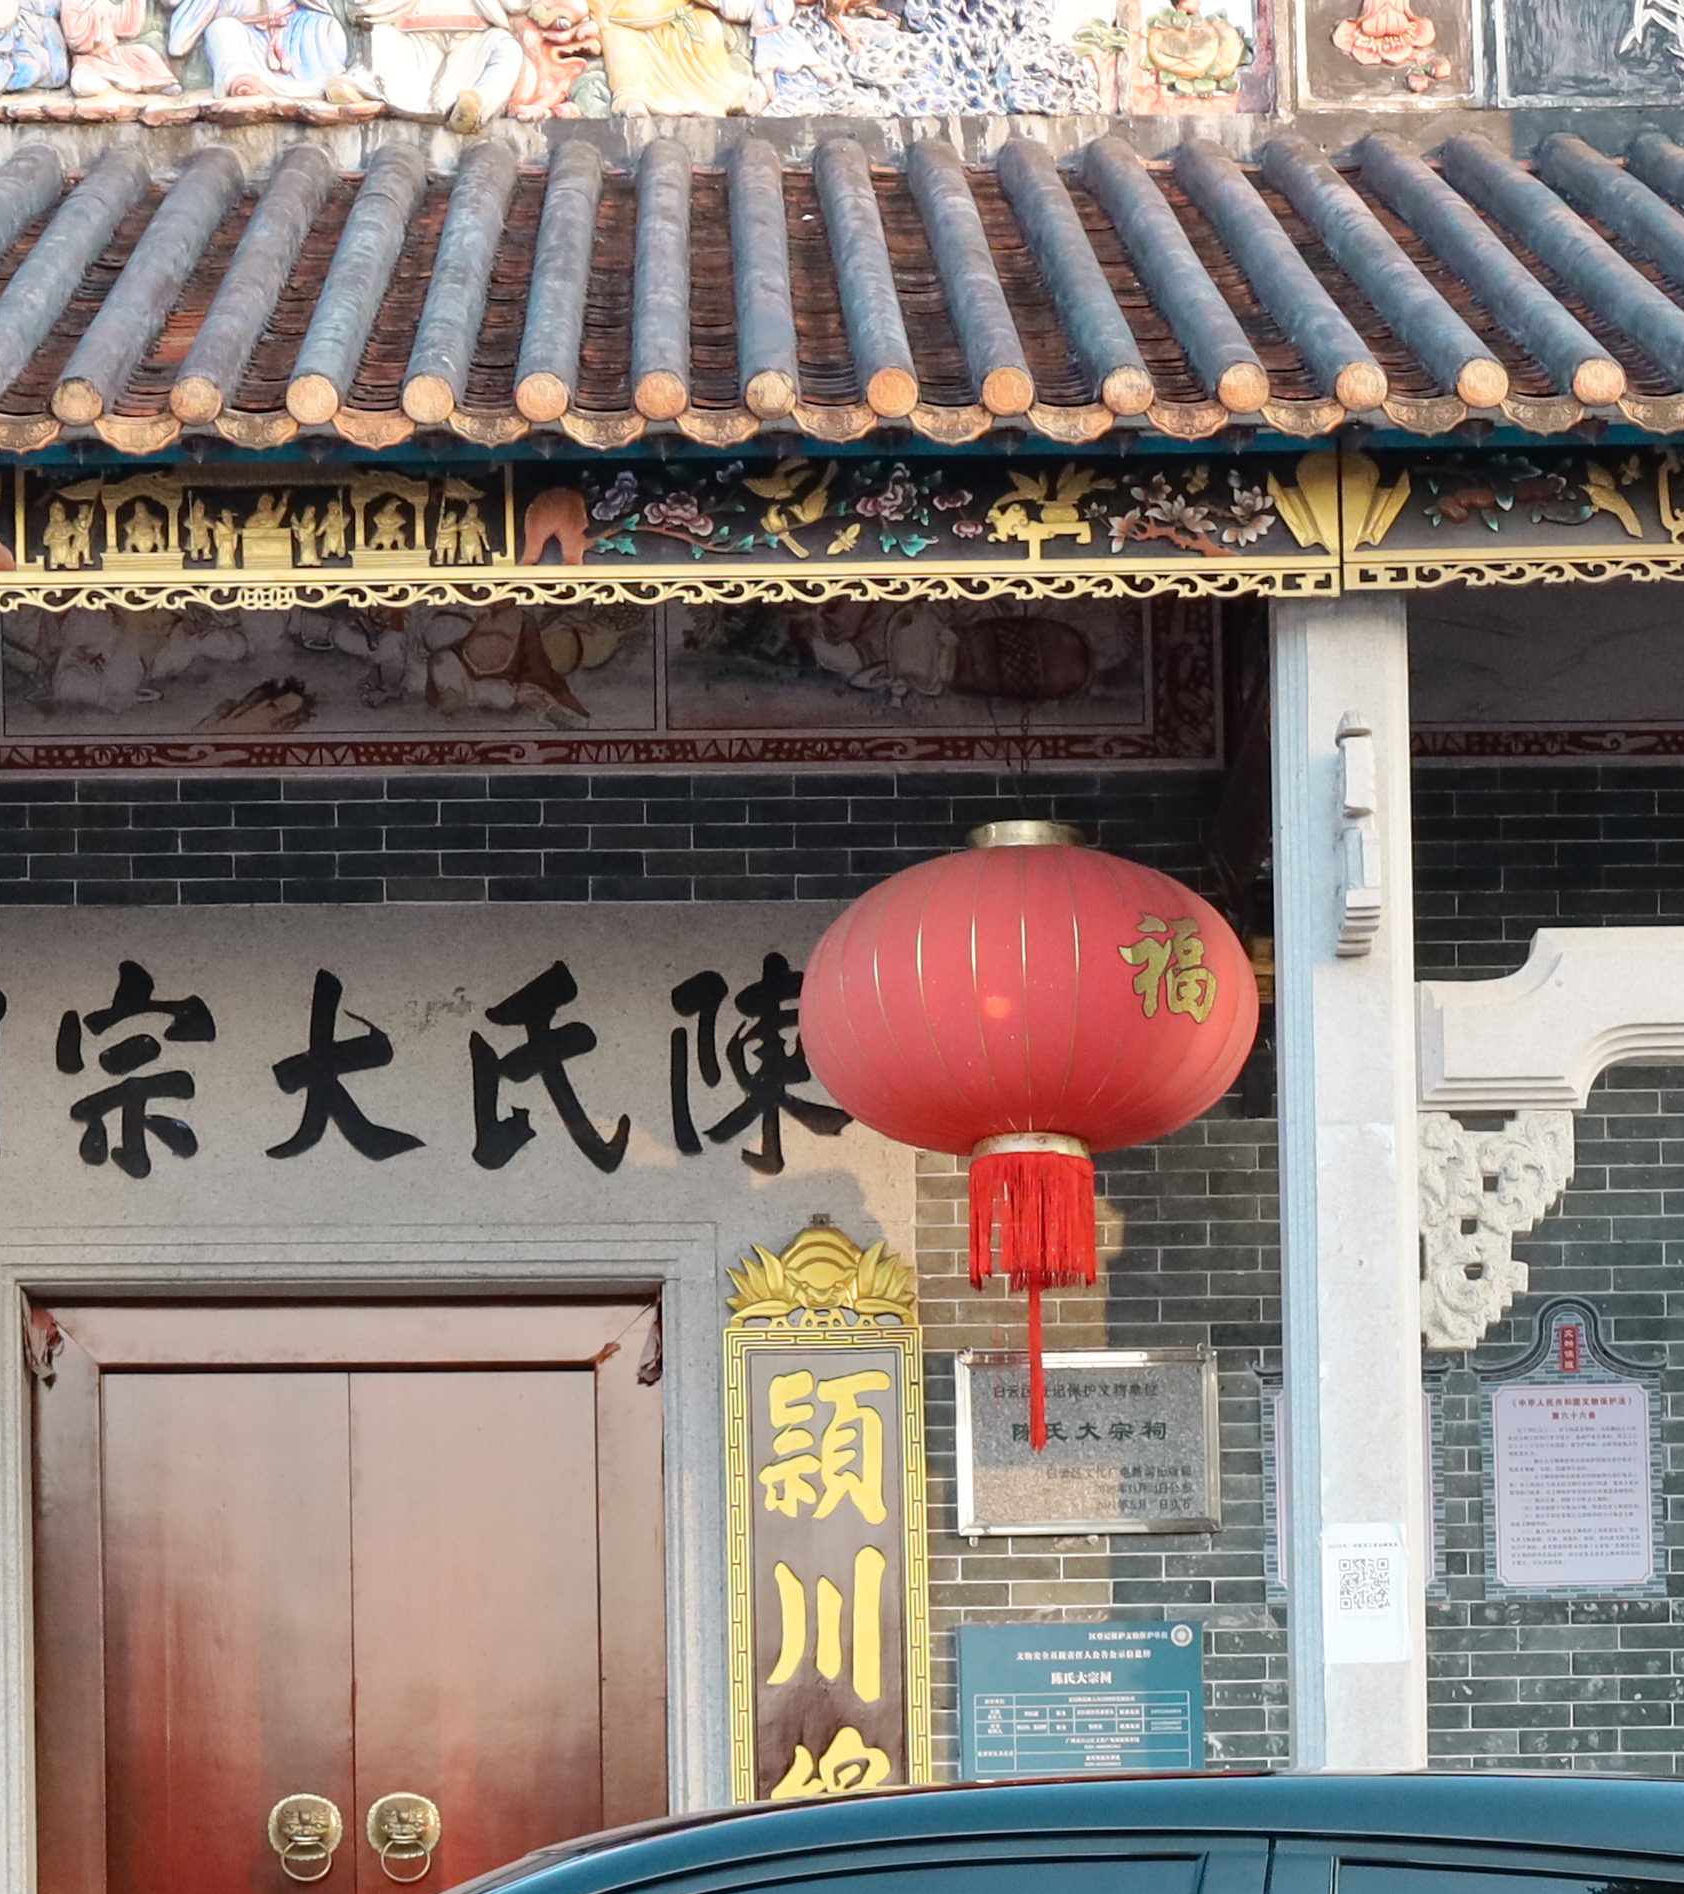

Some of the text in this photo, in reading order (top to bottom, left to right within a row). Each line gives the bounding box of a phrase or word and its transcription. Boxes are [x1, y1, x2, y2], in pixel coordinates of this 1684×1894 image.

[1118, 913, 1217, 1024] 福
[994, 1383, 1159, 1398] 白云区记保护文物单位
